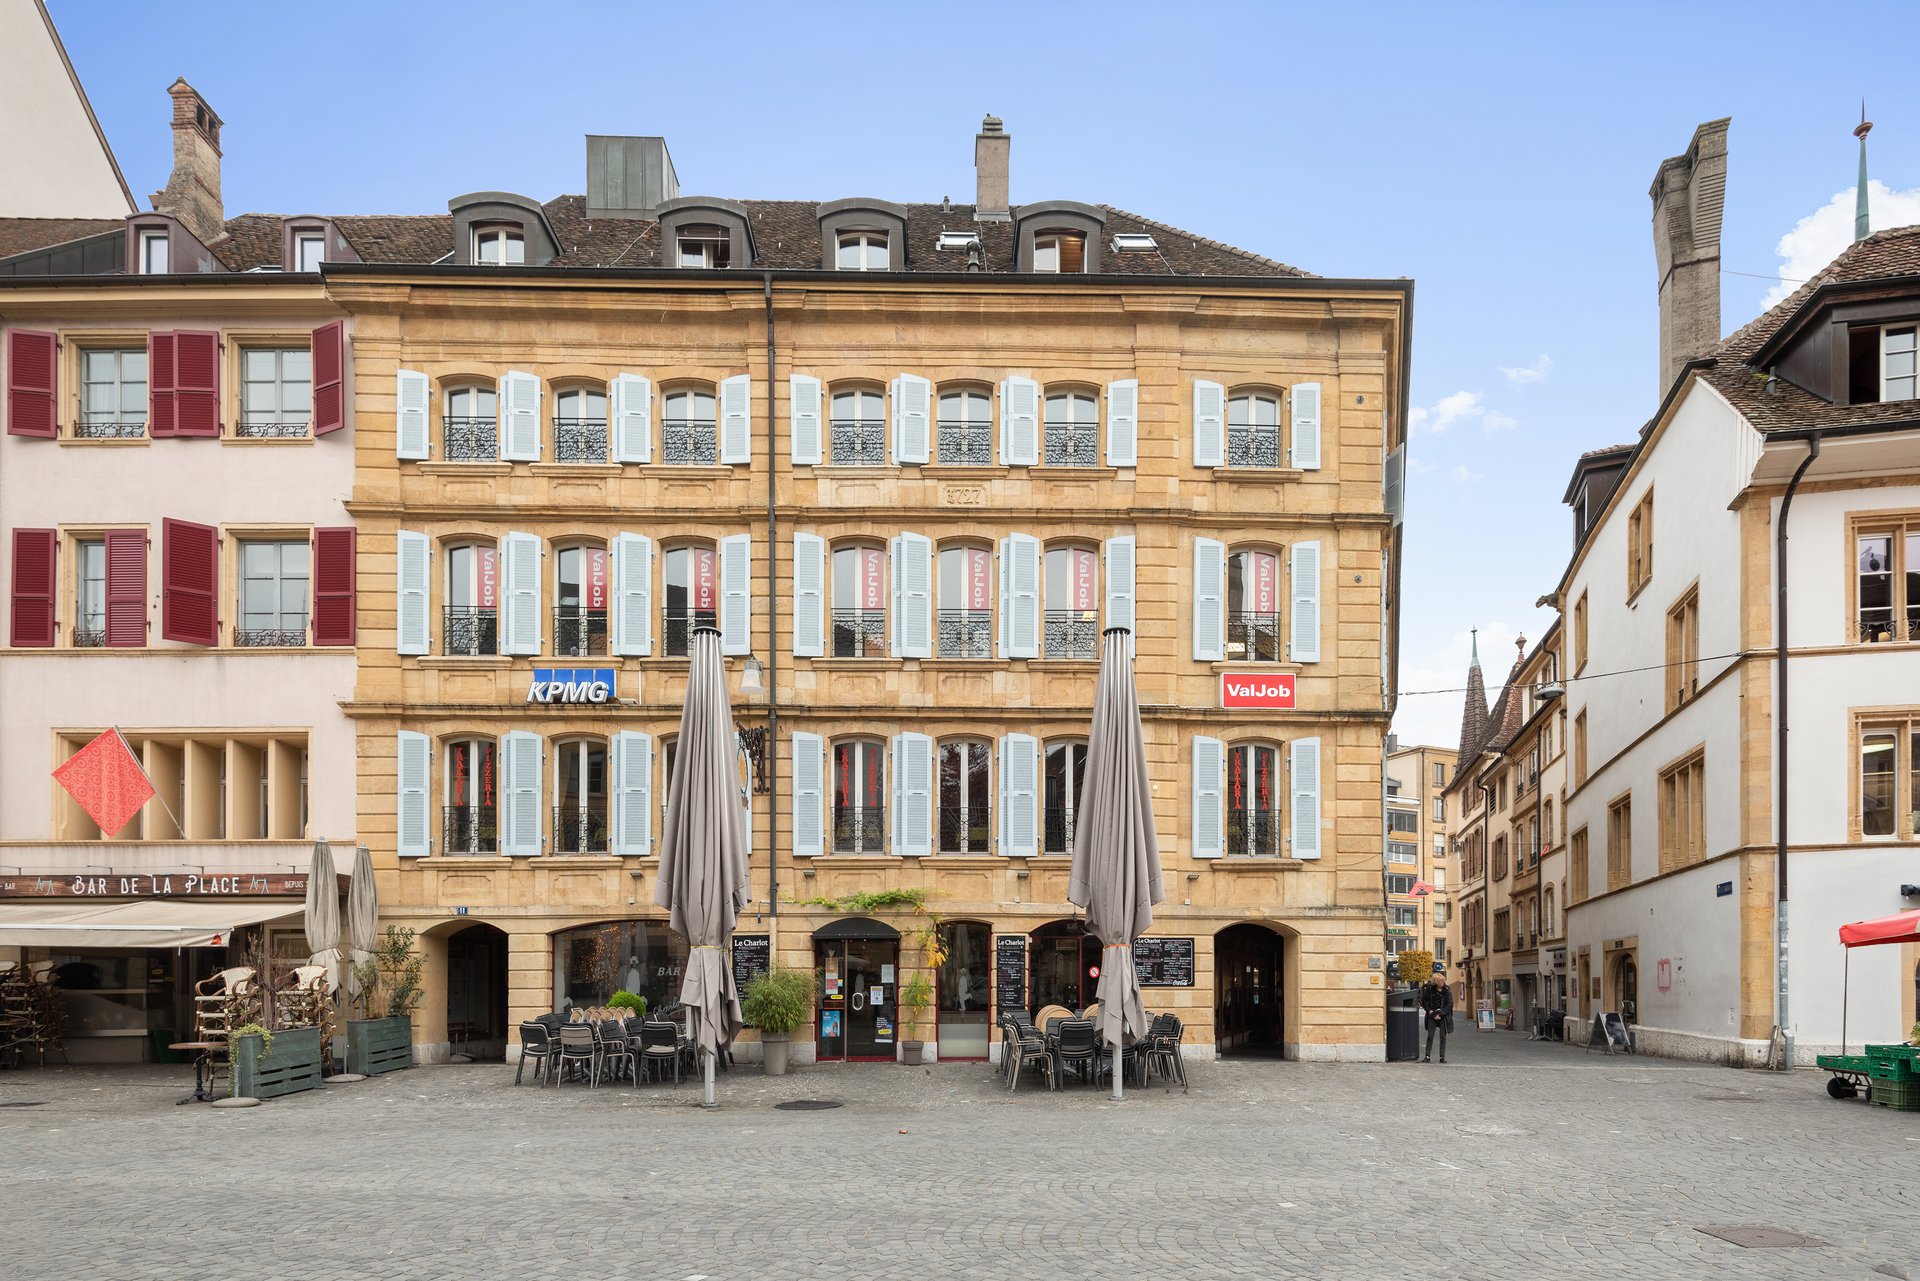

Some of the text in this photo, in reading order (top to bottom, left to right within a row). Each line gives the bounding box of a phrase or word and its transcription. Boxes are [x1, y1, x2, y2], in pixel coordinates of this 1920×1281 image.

[483, 552, 494, 606] ValJob
[592, 551, 603, 607] ValJob
[700, 552, 711, 608] ValJob
[867, 552, 878, 608] ValJob
[974, 552, 984, 608] ValJob
[1079, 553, 1089, 608] ValJob
[1260, 557, 1270, 612] ValJob
[527, 681, 610, 704] KPMG
[1227, 683, 1291, 697] ValJob
[484, 744, 492, 806] PIZZERIA
[72, 875, 240, 894] BAR DE LA PLACE
[285, 880, 304, 888] DEPUIS
[734, 939, 743, 947] Le
[657, 966, 681, 976] BAR
